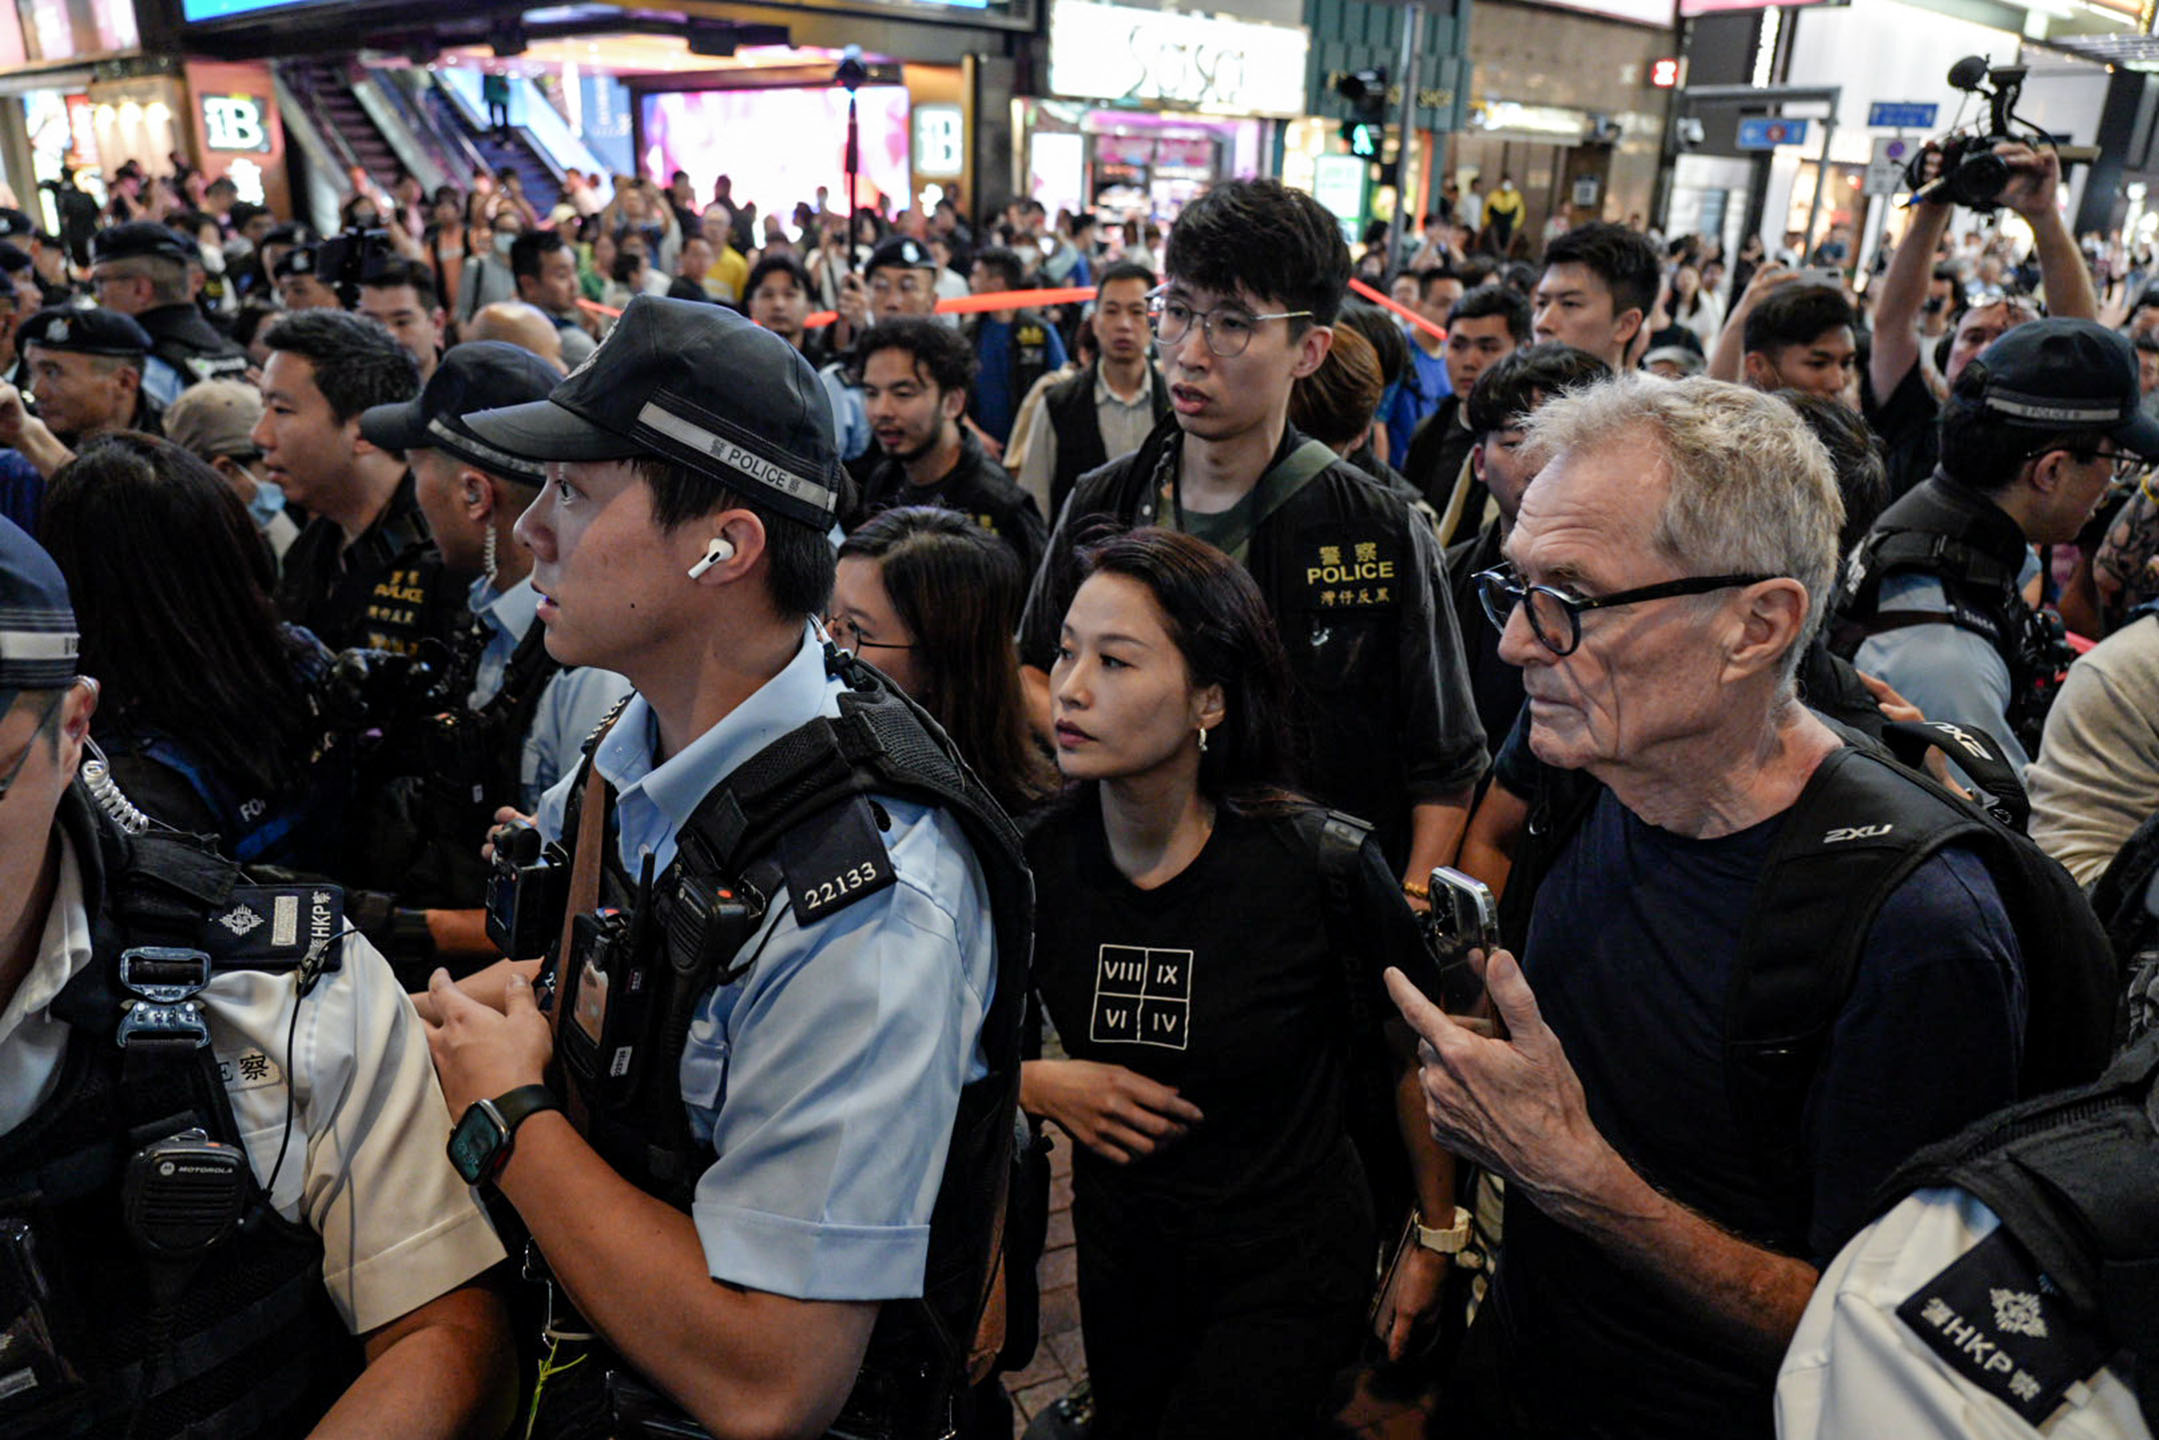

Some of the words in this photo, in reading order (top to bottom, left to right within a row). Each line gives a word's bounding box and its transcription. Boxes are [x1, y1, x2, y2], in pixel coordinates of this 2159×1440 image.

[728, 448, 788, 487] POLICE
[1307, 561, 1395, 585] POLICE
[804, 861, 877, 910] 22133
[1104, 960, 1142, 982] VIII
[1156, 964, 1178, 985] IX
[1105, 1008, 1127, 1029] VI
[1153, 1012, 1177, 1033] IV
[239, 1054, 269, 1081] 察
